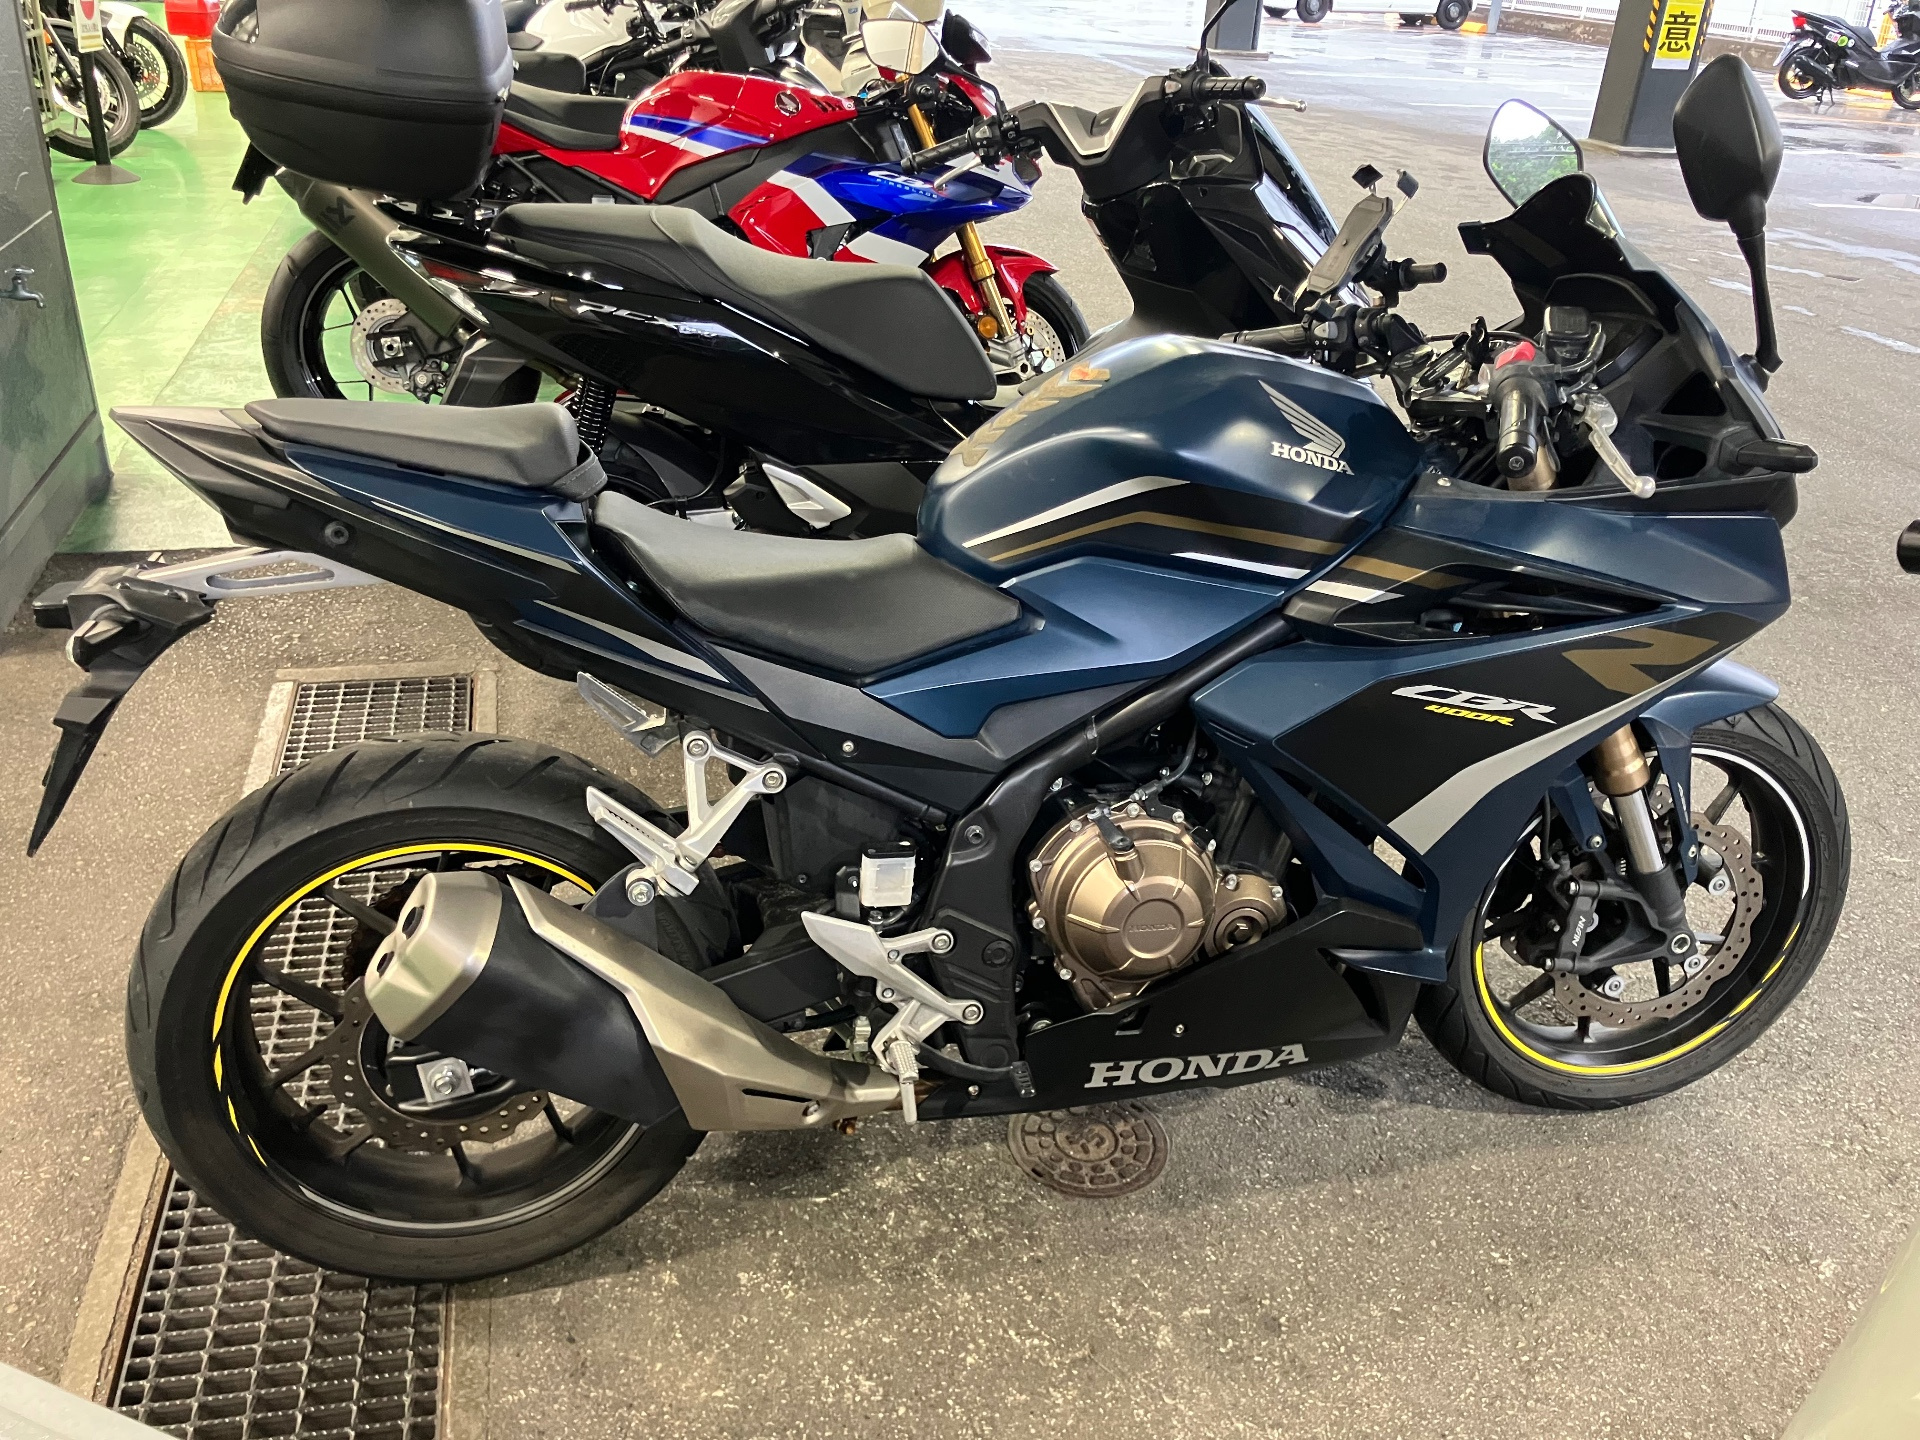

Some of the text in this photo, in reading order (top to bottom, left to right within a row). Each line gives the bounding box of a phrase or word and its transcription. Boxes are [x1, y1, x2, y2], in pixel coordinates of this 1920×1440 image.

[1658, 10, 1697, 52] 意
[576, 299, 678, 330] PCX
[1270, 441, 1355, 476] HONDA
[1391, 684, 1558, 725] CBR
[1423, 704, 1515, 727] 400R
[1084, 1043, 1309, 1089] HONDA
